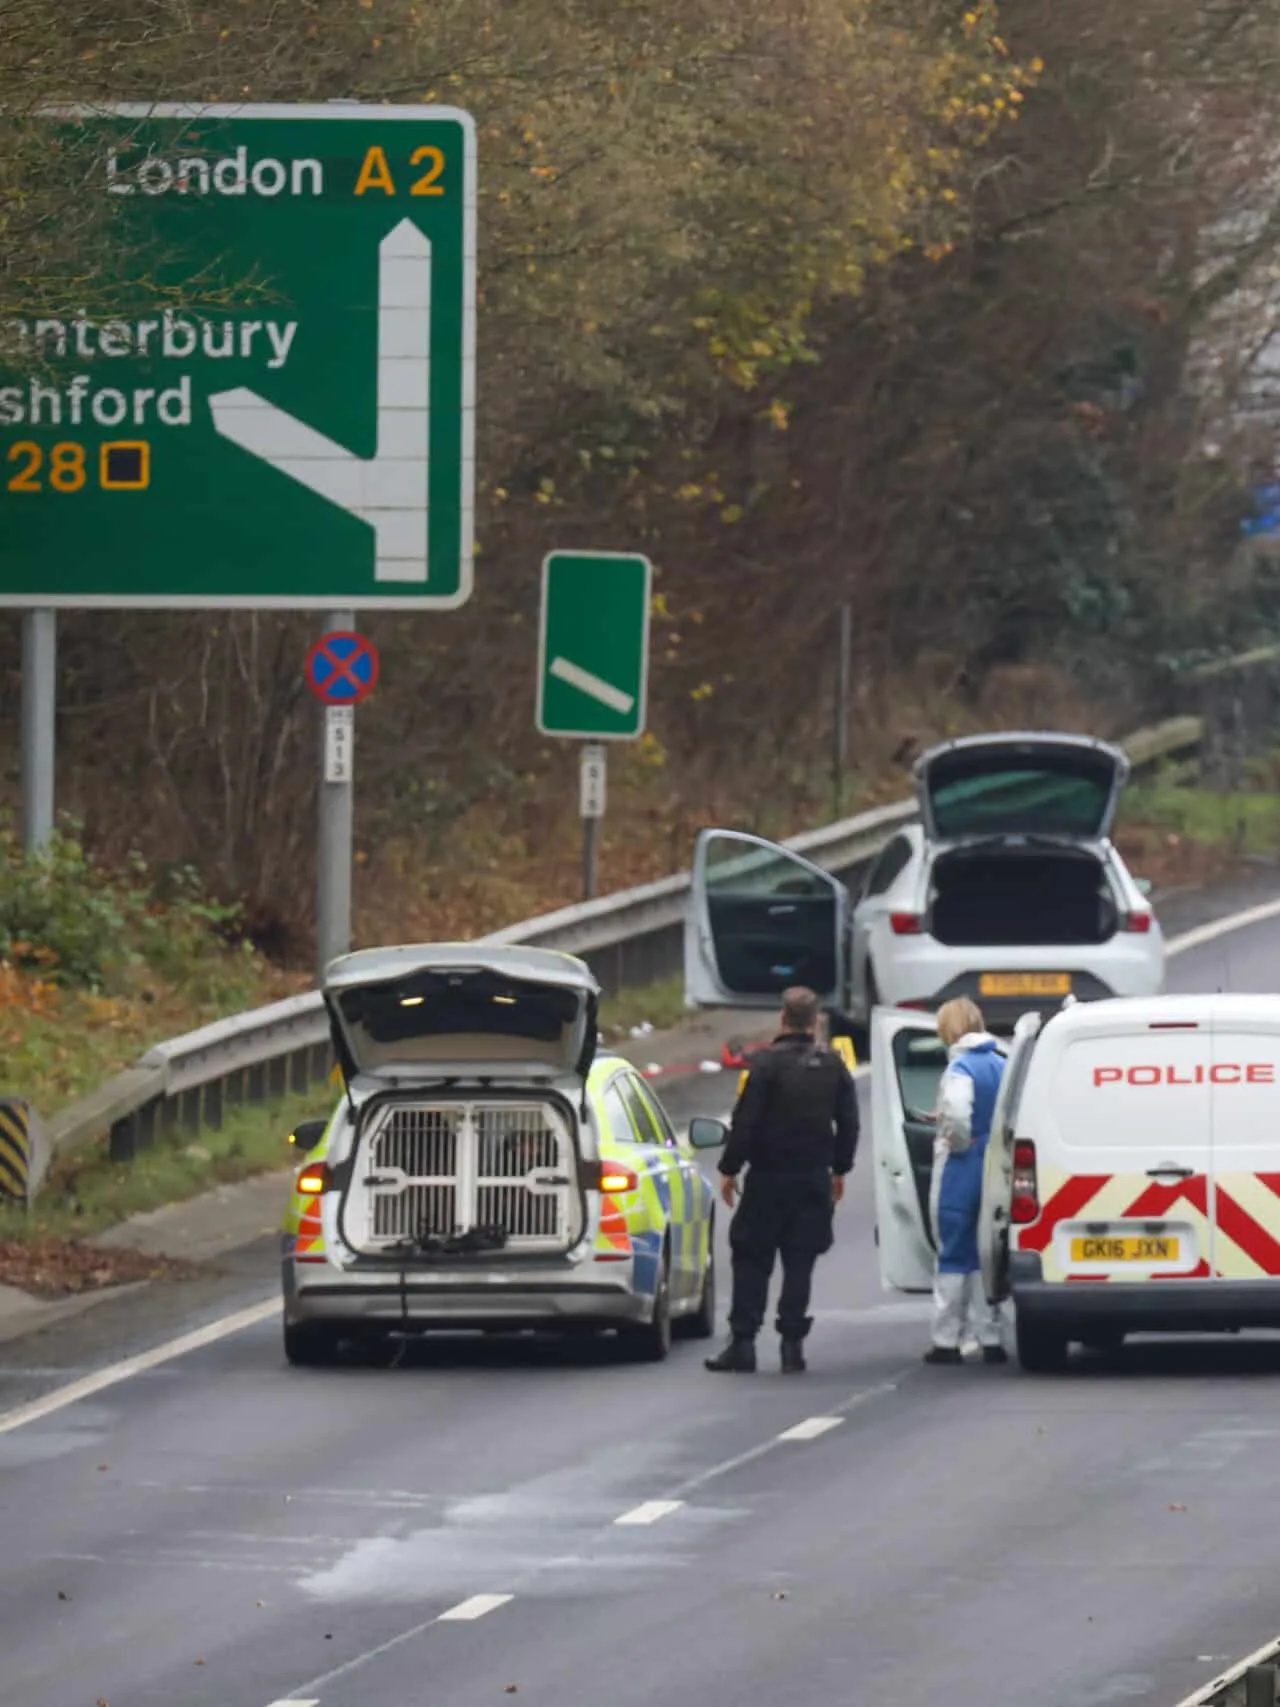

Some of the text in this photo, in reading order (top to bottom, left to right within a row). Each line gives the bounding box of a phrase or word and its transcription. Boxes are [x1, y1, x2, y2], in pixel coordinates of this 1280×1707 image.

[107, 145, 446, 196] London A2
[1092, 1063, 1276, 1087] POLICE
